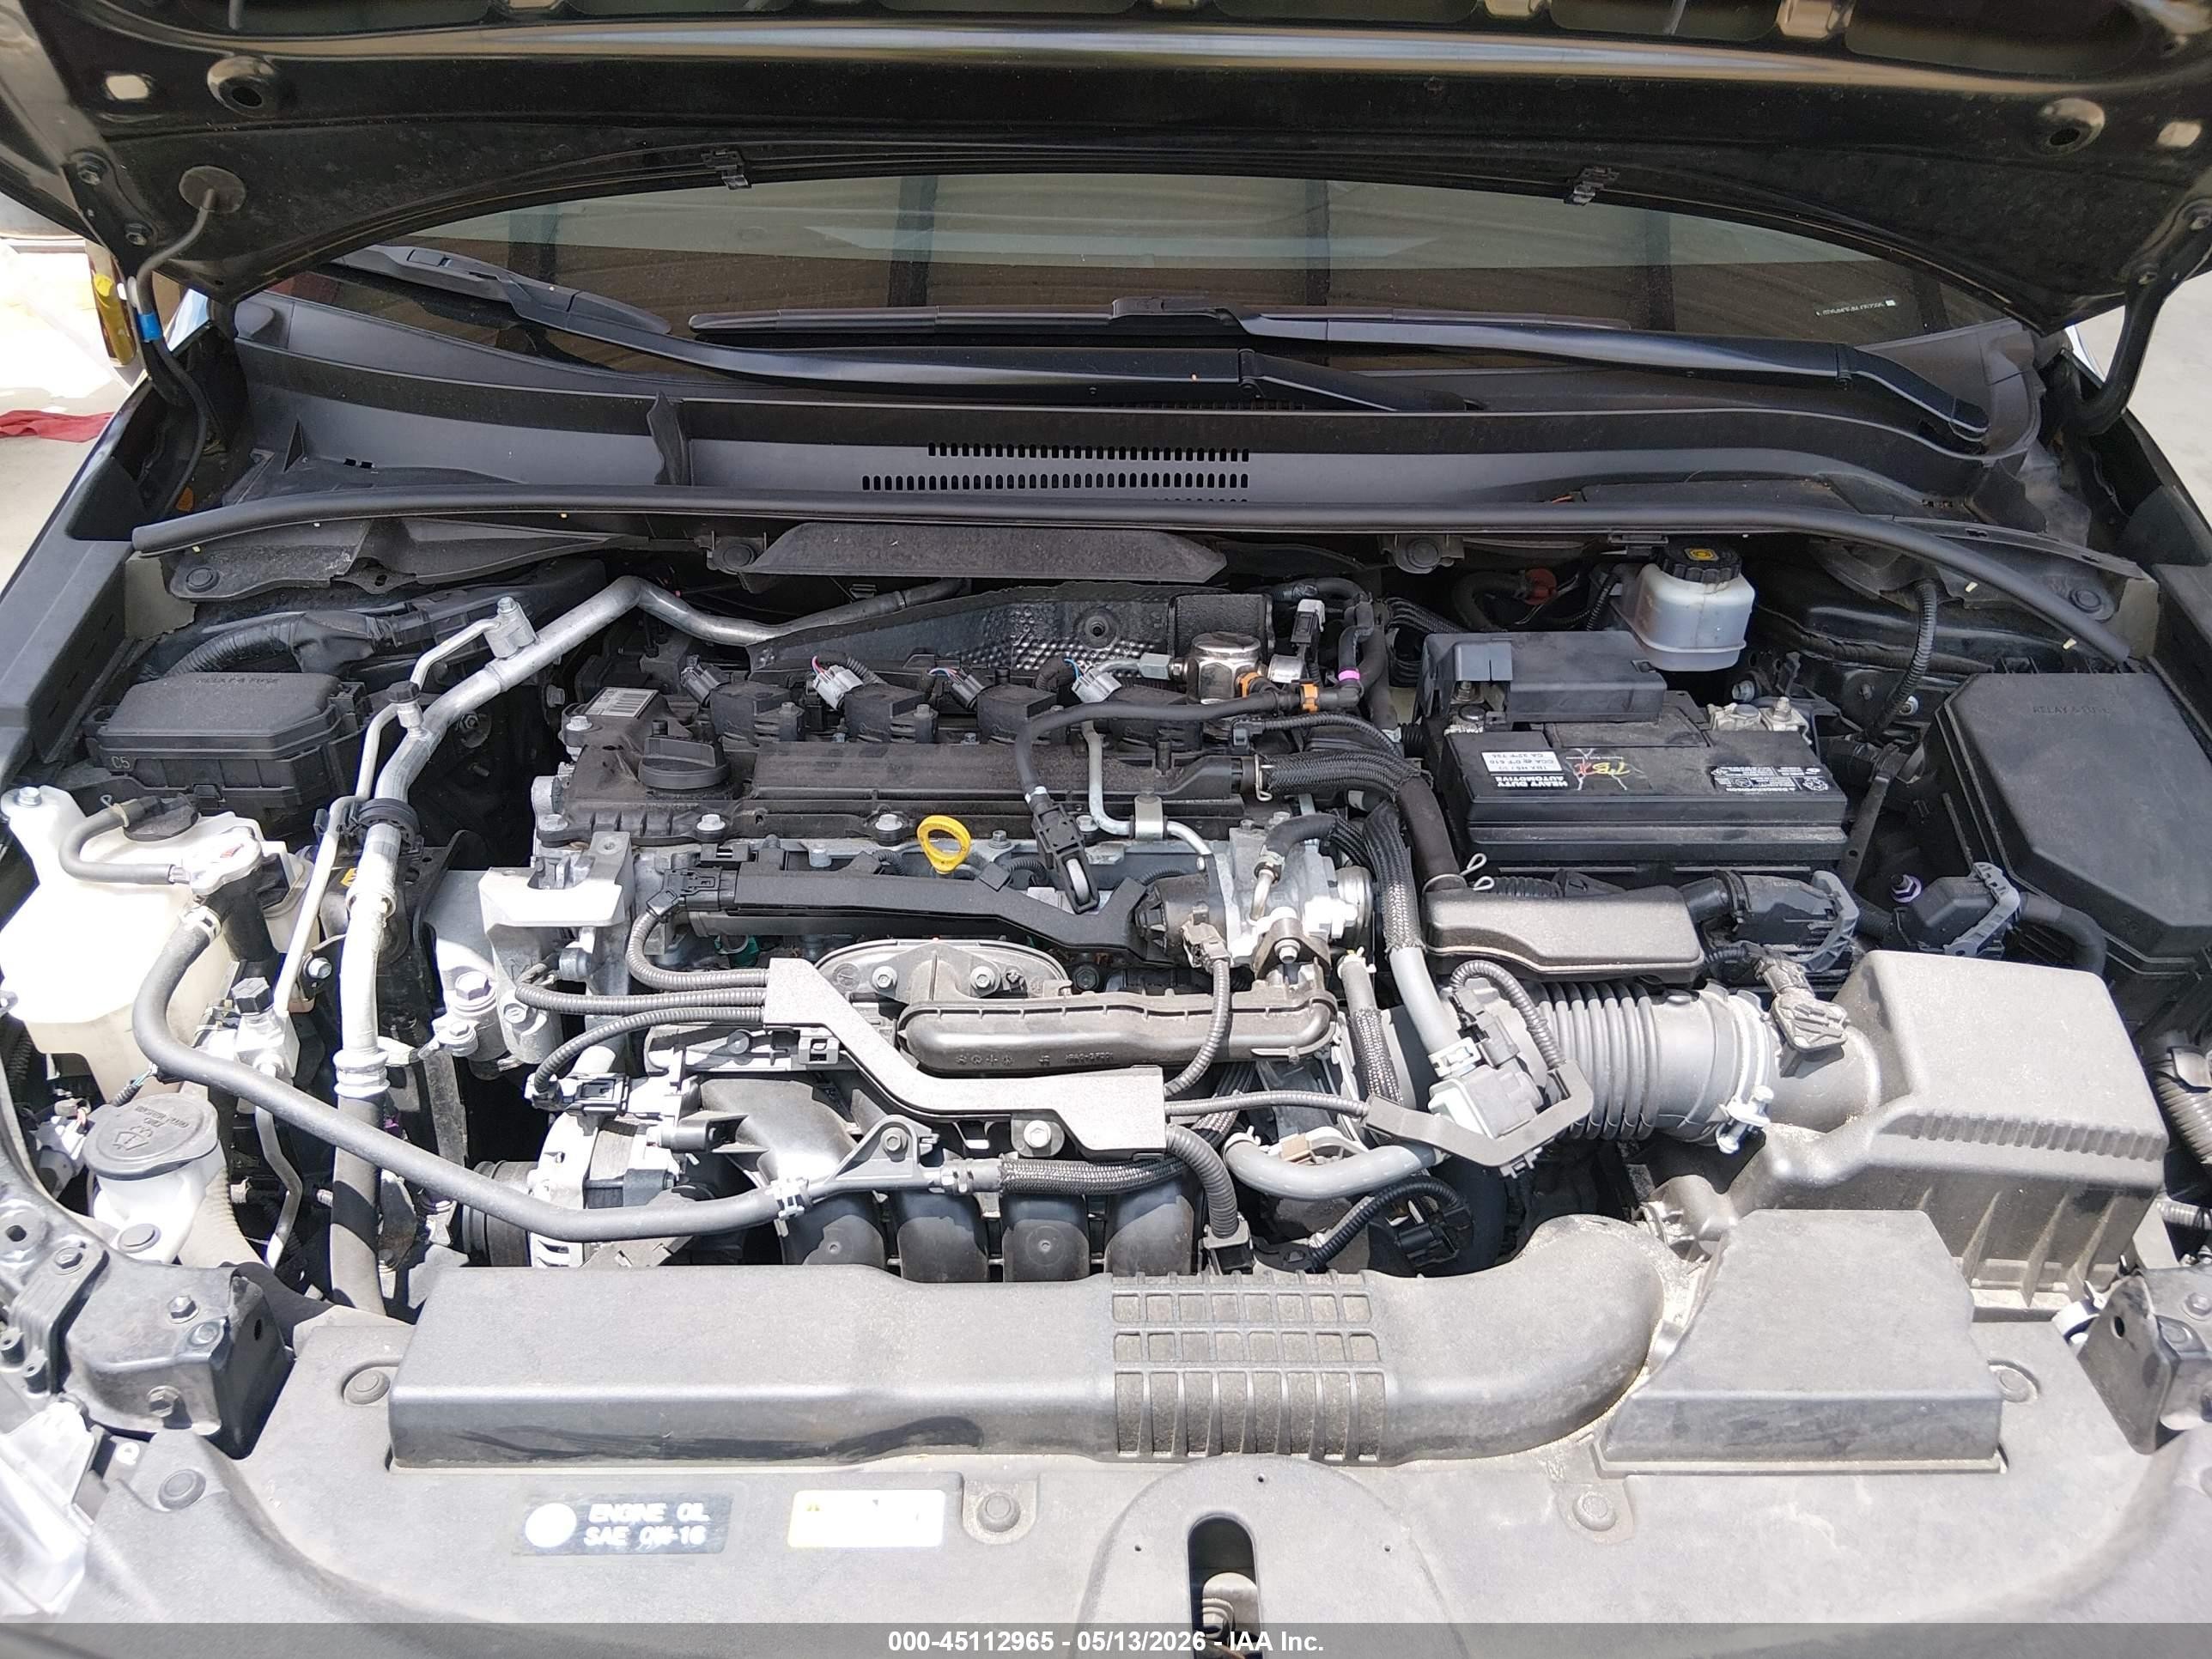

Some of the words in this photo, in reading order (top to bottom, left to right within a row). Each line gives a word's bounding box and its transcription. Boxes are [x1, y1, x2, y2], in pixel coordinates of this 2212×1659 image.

[111, 756, 131, 769] C5
[587, 1503, 668, 1523] ENGINE
[583, 1525, 630, 1547] SAE
